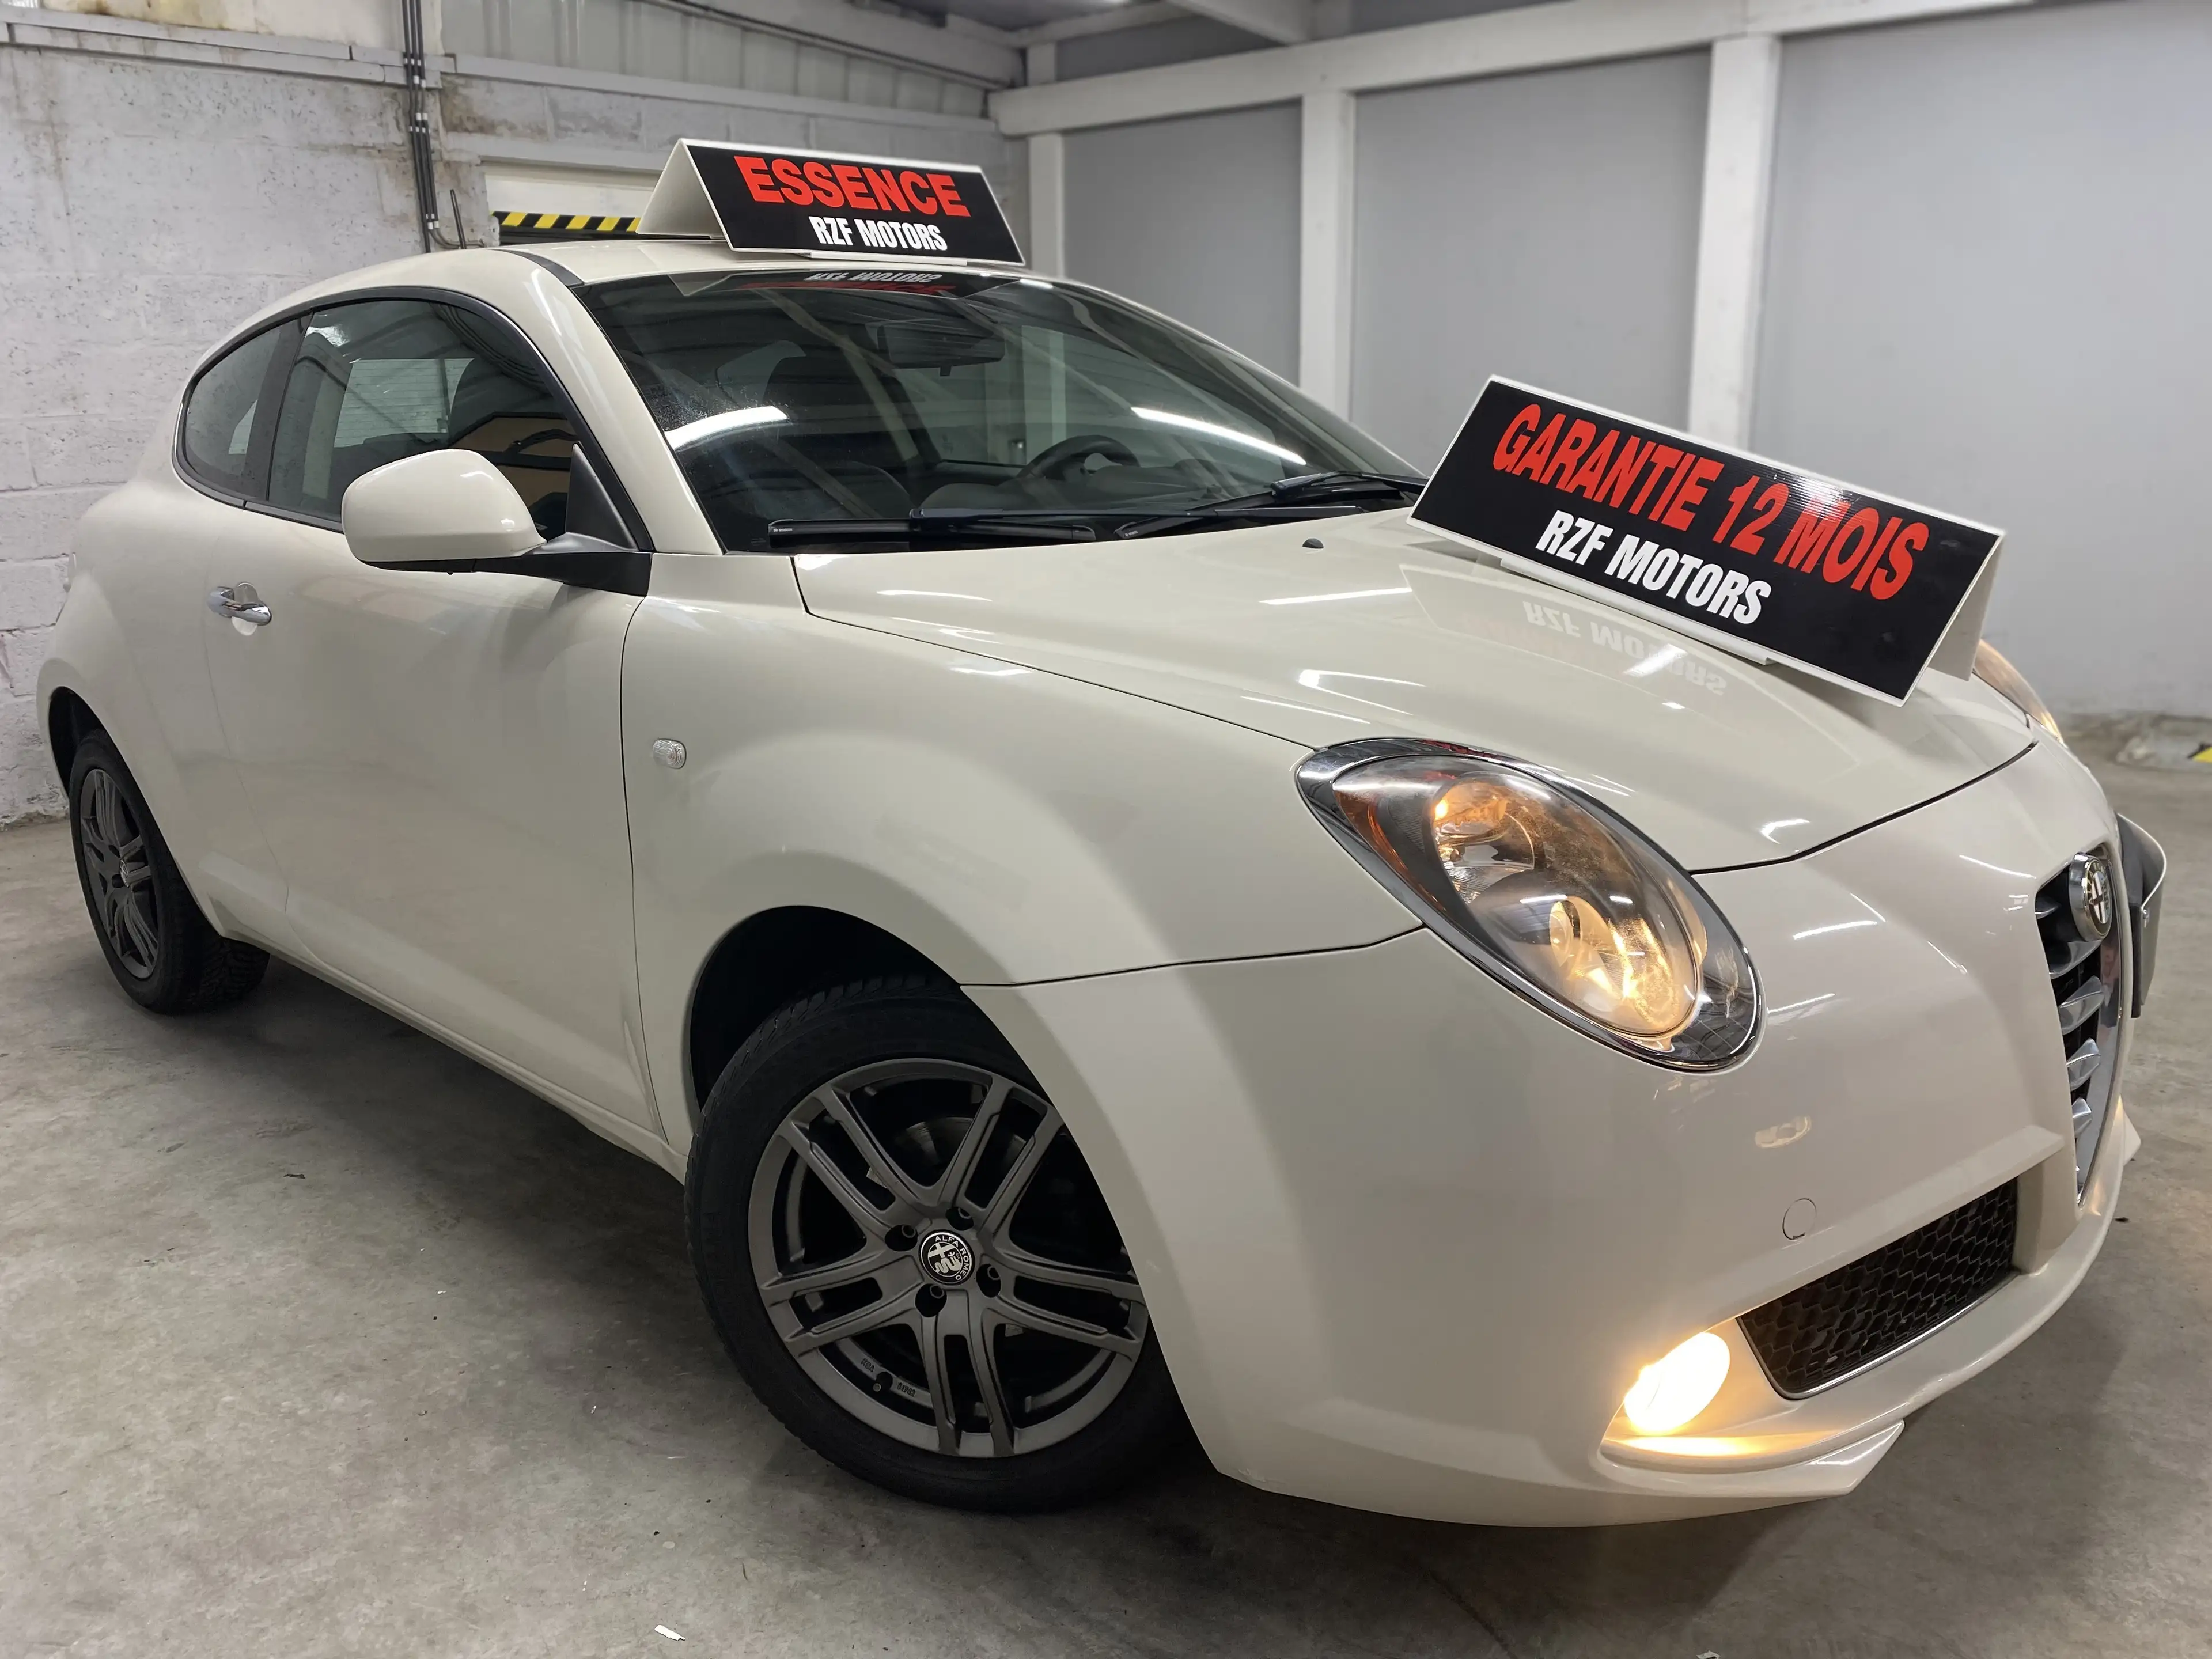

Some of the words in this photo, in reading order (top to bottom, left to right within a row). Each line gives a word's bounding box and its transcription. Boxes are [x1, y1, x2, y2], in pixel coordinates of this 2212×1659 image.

[734, 156, 971, 217] ESSENCE
[808, 216, 853, 245] RZF
[854, 219, 948, 251] MOTORS
[1493, 404, 1724, 531] GARANTIE
[1713, 475, 1789, 555] 12
[1774, 498, 1929, 600] MOIS
[1536, 510, 1614, 565] RZF
[1605, 534, 1772, 624] MOTORS
[935, 1235, 959, 1248] ALFA
[955, 1248, 969, 1281] ROMEO
